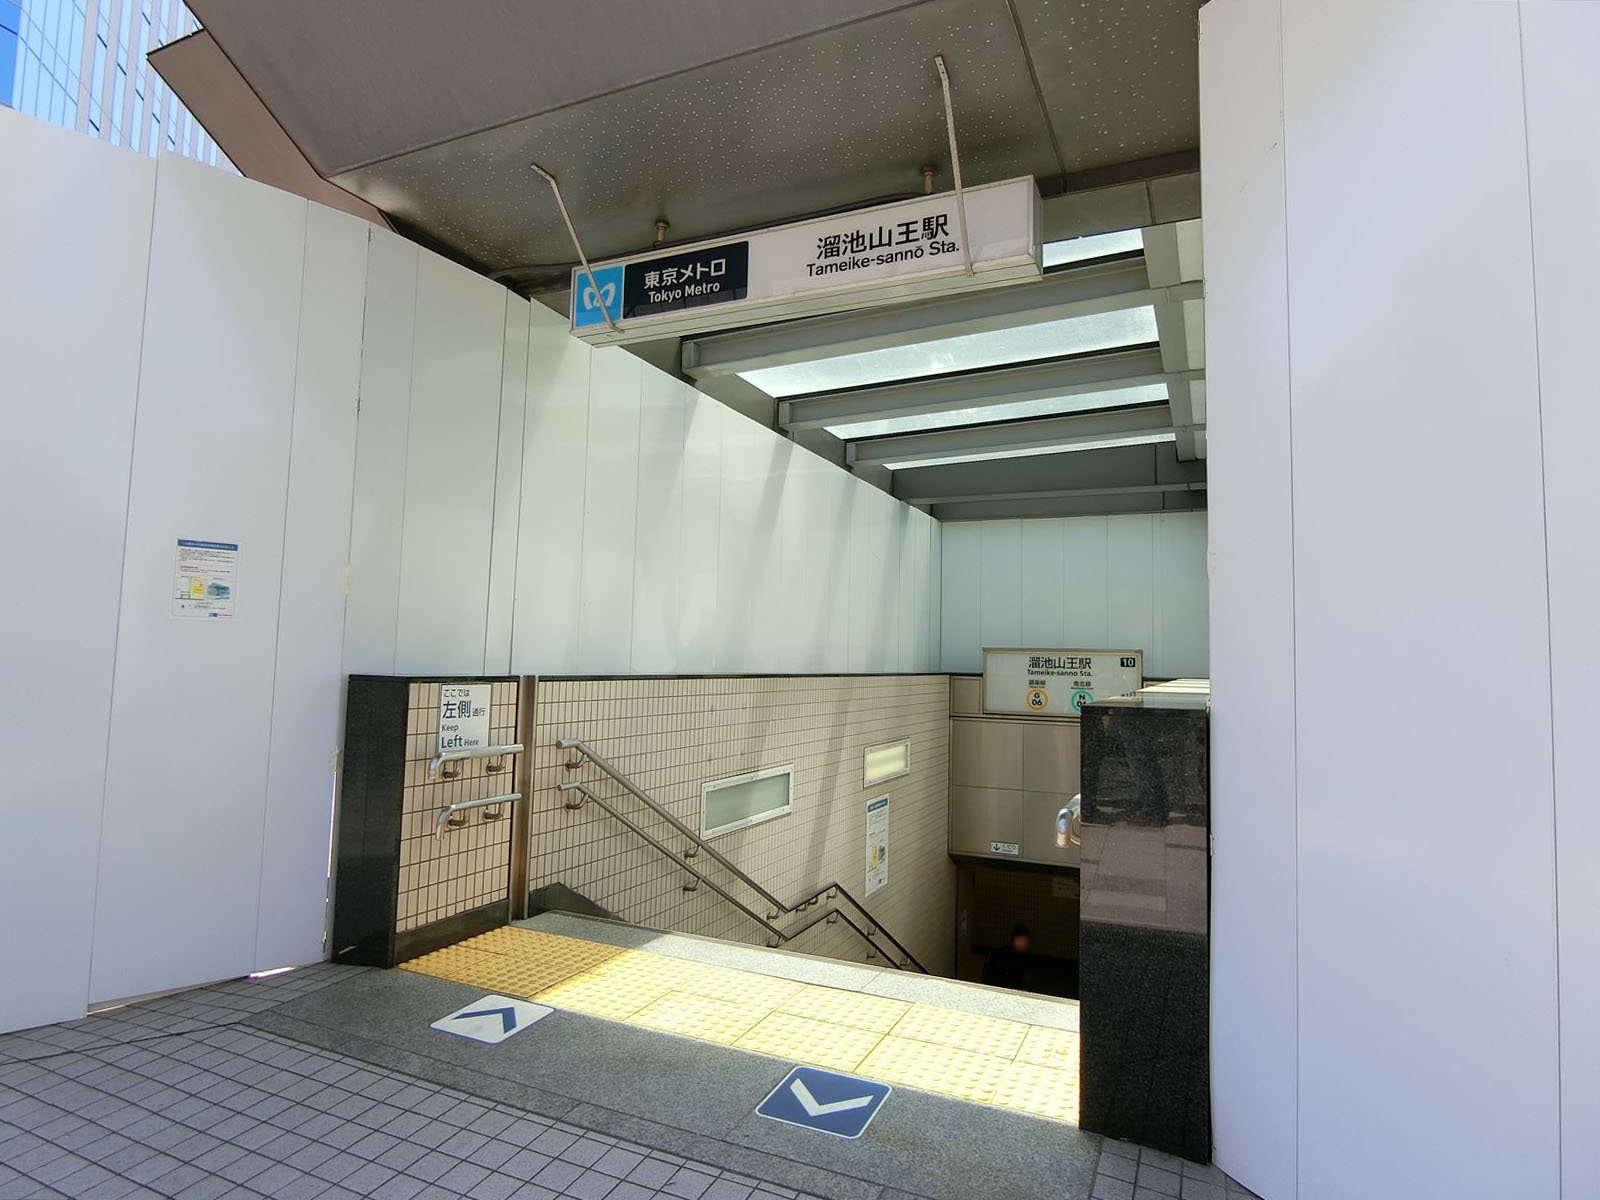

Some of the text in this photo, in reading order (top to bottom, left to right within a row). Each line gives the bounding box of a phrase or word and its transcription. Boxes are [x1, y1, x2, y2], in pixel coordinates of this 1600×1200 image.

[817, 213, 949, 260] 溜池山王駅
[806, 240, 960, 277] Tameike-sannō Sta.
[644, 258, 726, 290] 東京メトロ
[648, 282, 720, 304] Tokyo Metro
[1028, 656, 1092, 670] 溜池山王駅
[1122, 658, 1135, 668] 10
[444, 688, 470, 698] ここでは
[1031, 698, 1043, 706] 06
[441, 723, 459, 733] Keep
[441, 734, 463, 749] Left
